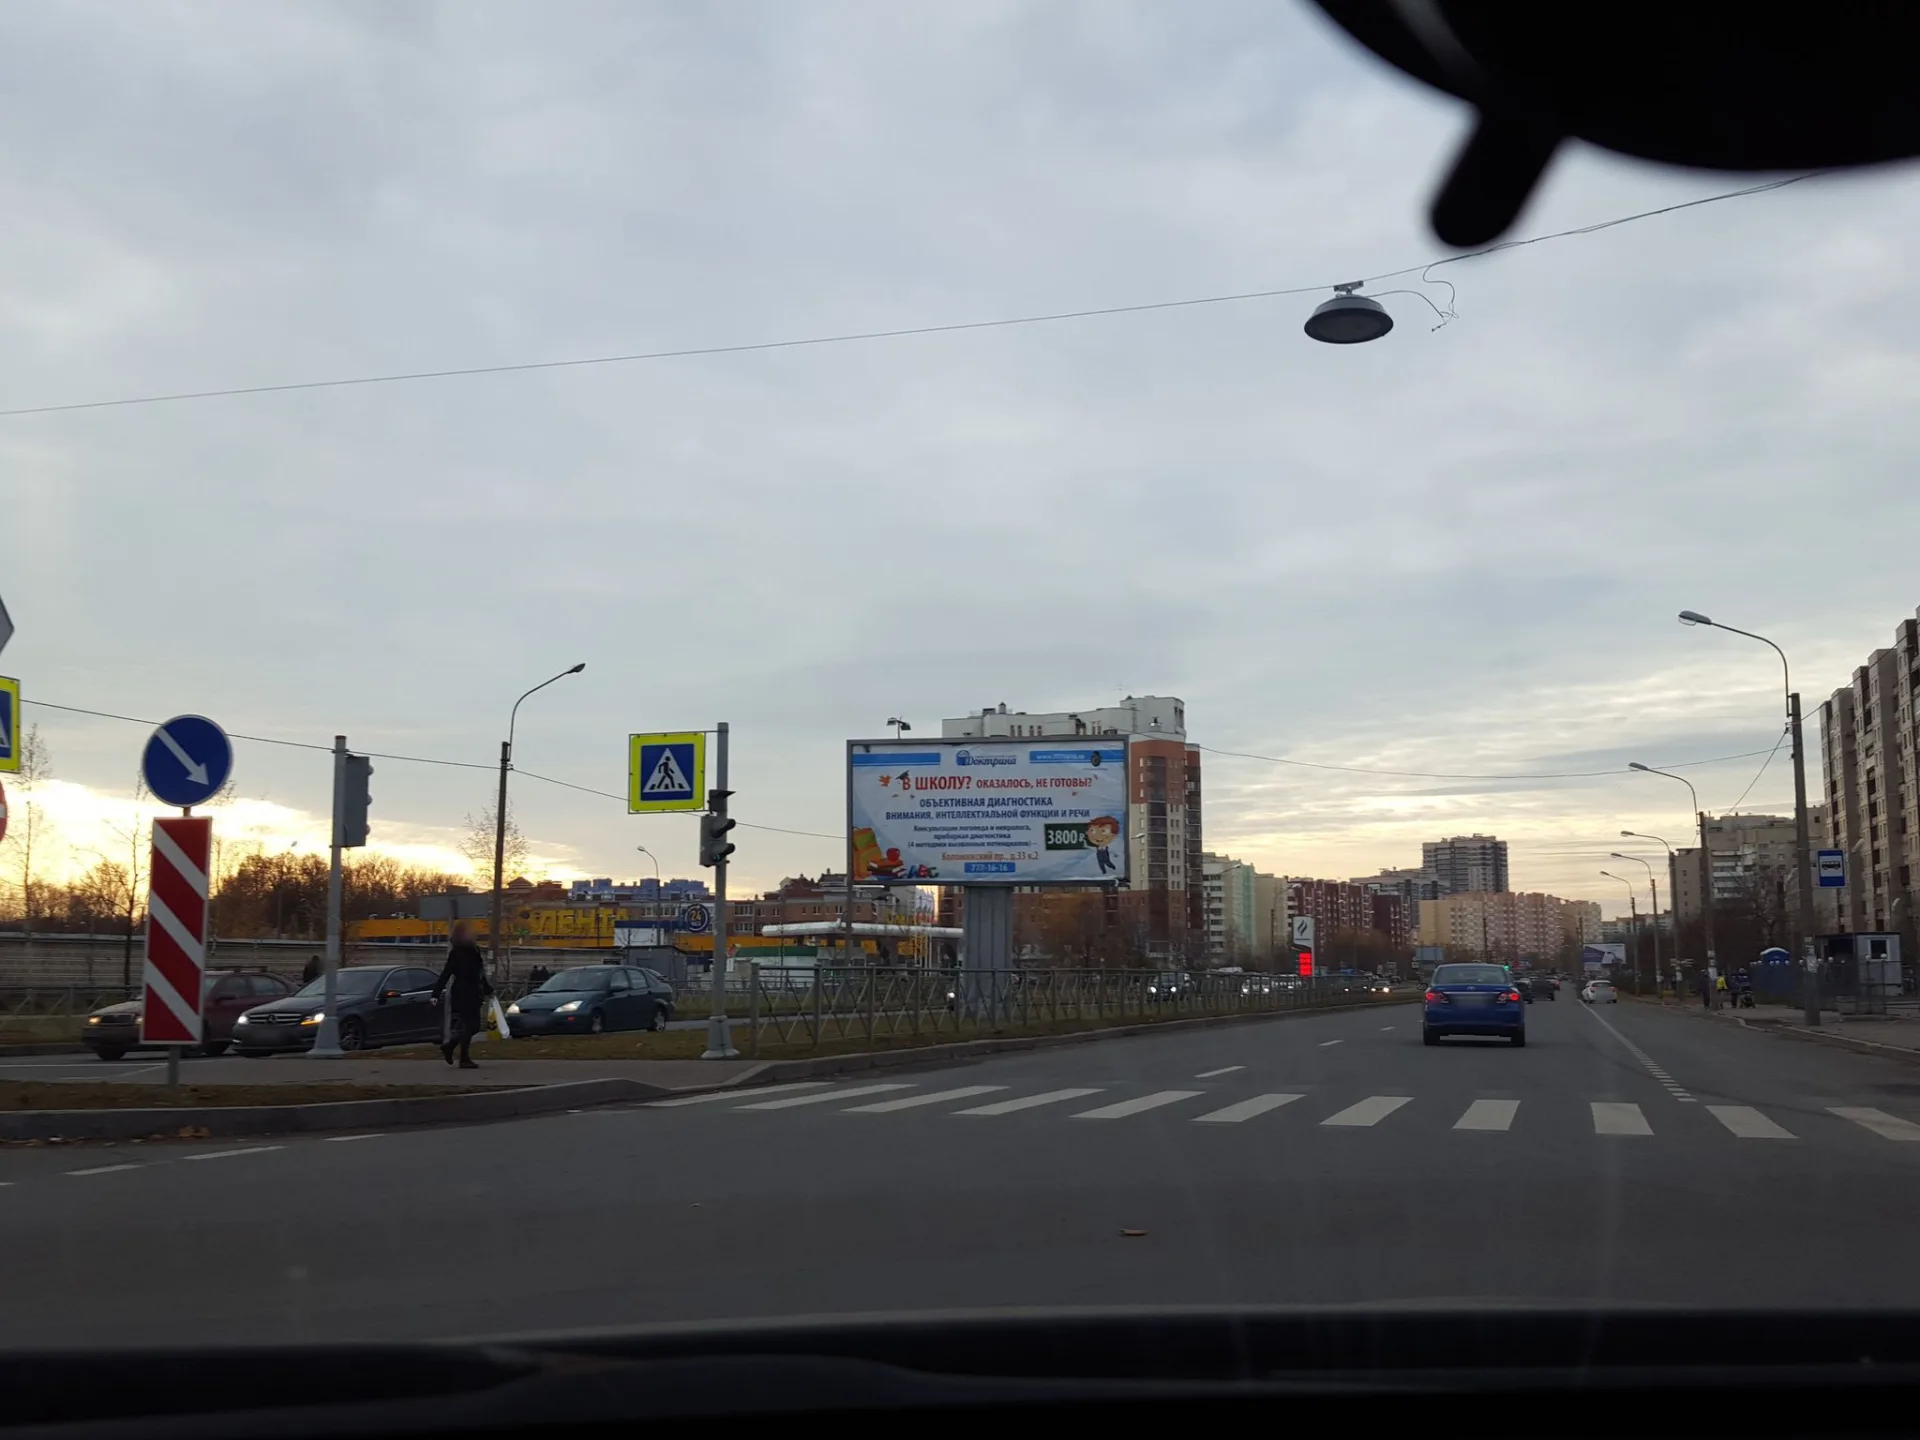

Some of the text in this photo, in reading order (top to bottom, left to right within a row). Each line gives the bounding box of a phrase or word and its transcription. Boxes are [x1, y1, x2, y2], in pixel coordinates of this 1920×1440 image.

[903, 775, 1092, 790] В ШКОЛУ? ОКАЗАЛОСЬ, НЕ ГОТОВЫ?
[919, 796, 1053, 808] ОБЪЕКТИВНАЯ ДИАГНОСТИКА
[885, 808, 1090, 820] ВНИМАНИЯ, ИНТЕЛЛЕКТУАЛЬНОЙ ФУНКЦИИ И РЕЧИ
